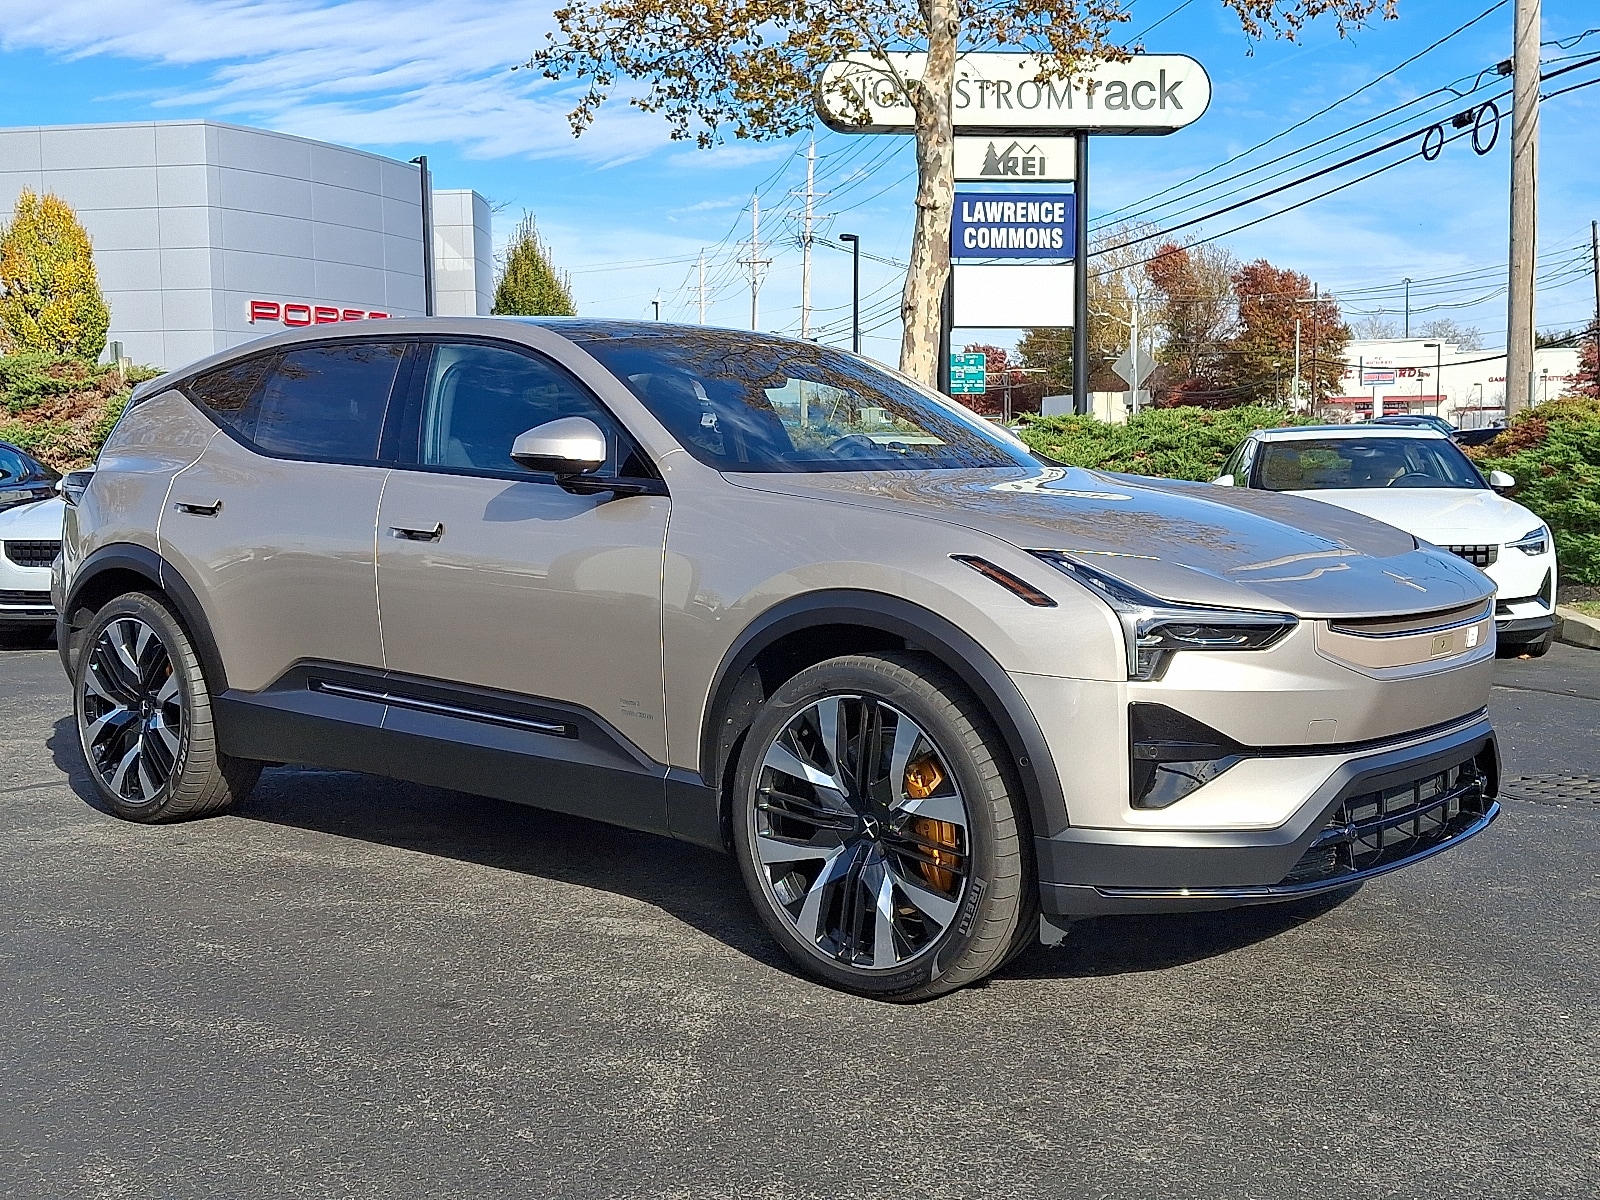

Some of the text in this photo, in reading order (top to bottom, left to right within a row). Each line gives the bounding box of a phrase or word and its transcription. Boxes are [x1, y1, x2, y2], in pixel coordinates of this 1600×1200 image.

[846, 69, 1184, 111] NOSTROM rack
[1002, 156, 1046, 177] REI
[961, 201, 1065, 224] LAWRENCE
[963, 226, 1064, 250] COMMONS
[250, 300, 396, 326] PORS
